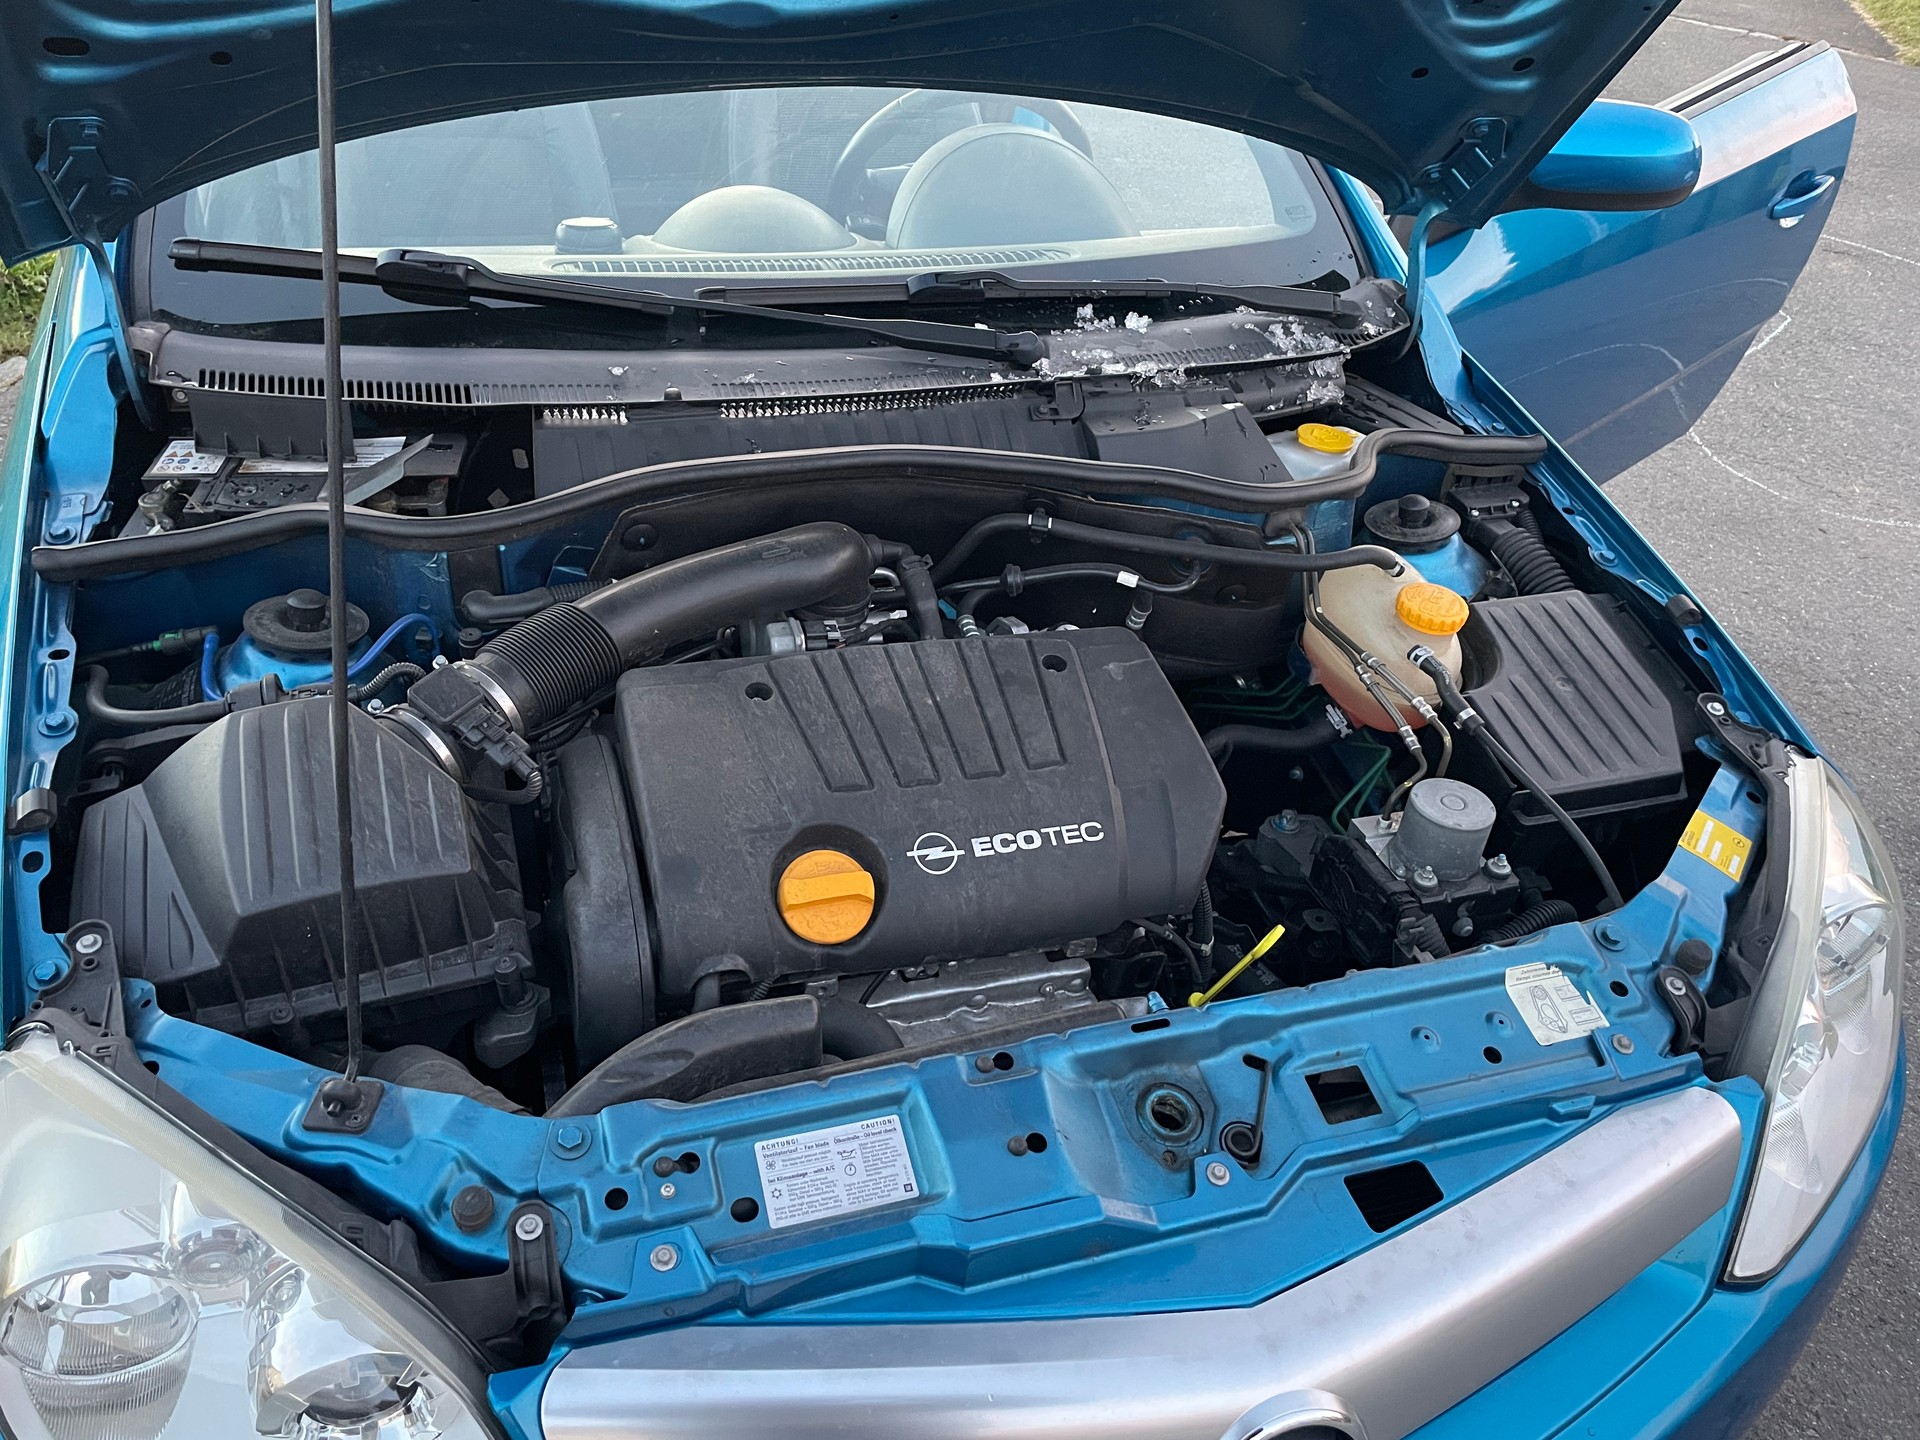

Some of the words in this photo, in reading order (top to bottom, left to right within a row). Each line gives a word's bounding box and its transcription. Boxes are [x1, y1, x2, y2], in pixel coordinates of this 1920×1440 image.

[971, 821, 1105, 858] ECOTEC
[861, 1119, 895, 1130] CAUTION!
[762, 1138, 798, 1150] ACHTUNG!
[763, 1147, 798, 1158] Ventilatorlauf
